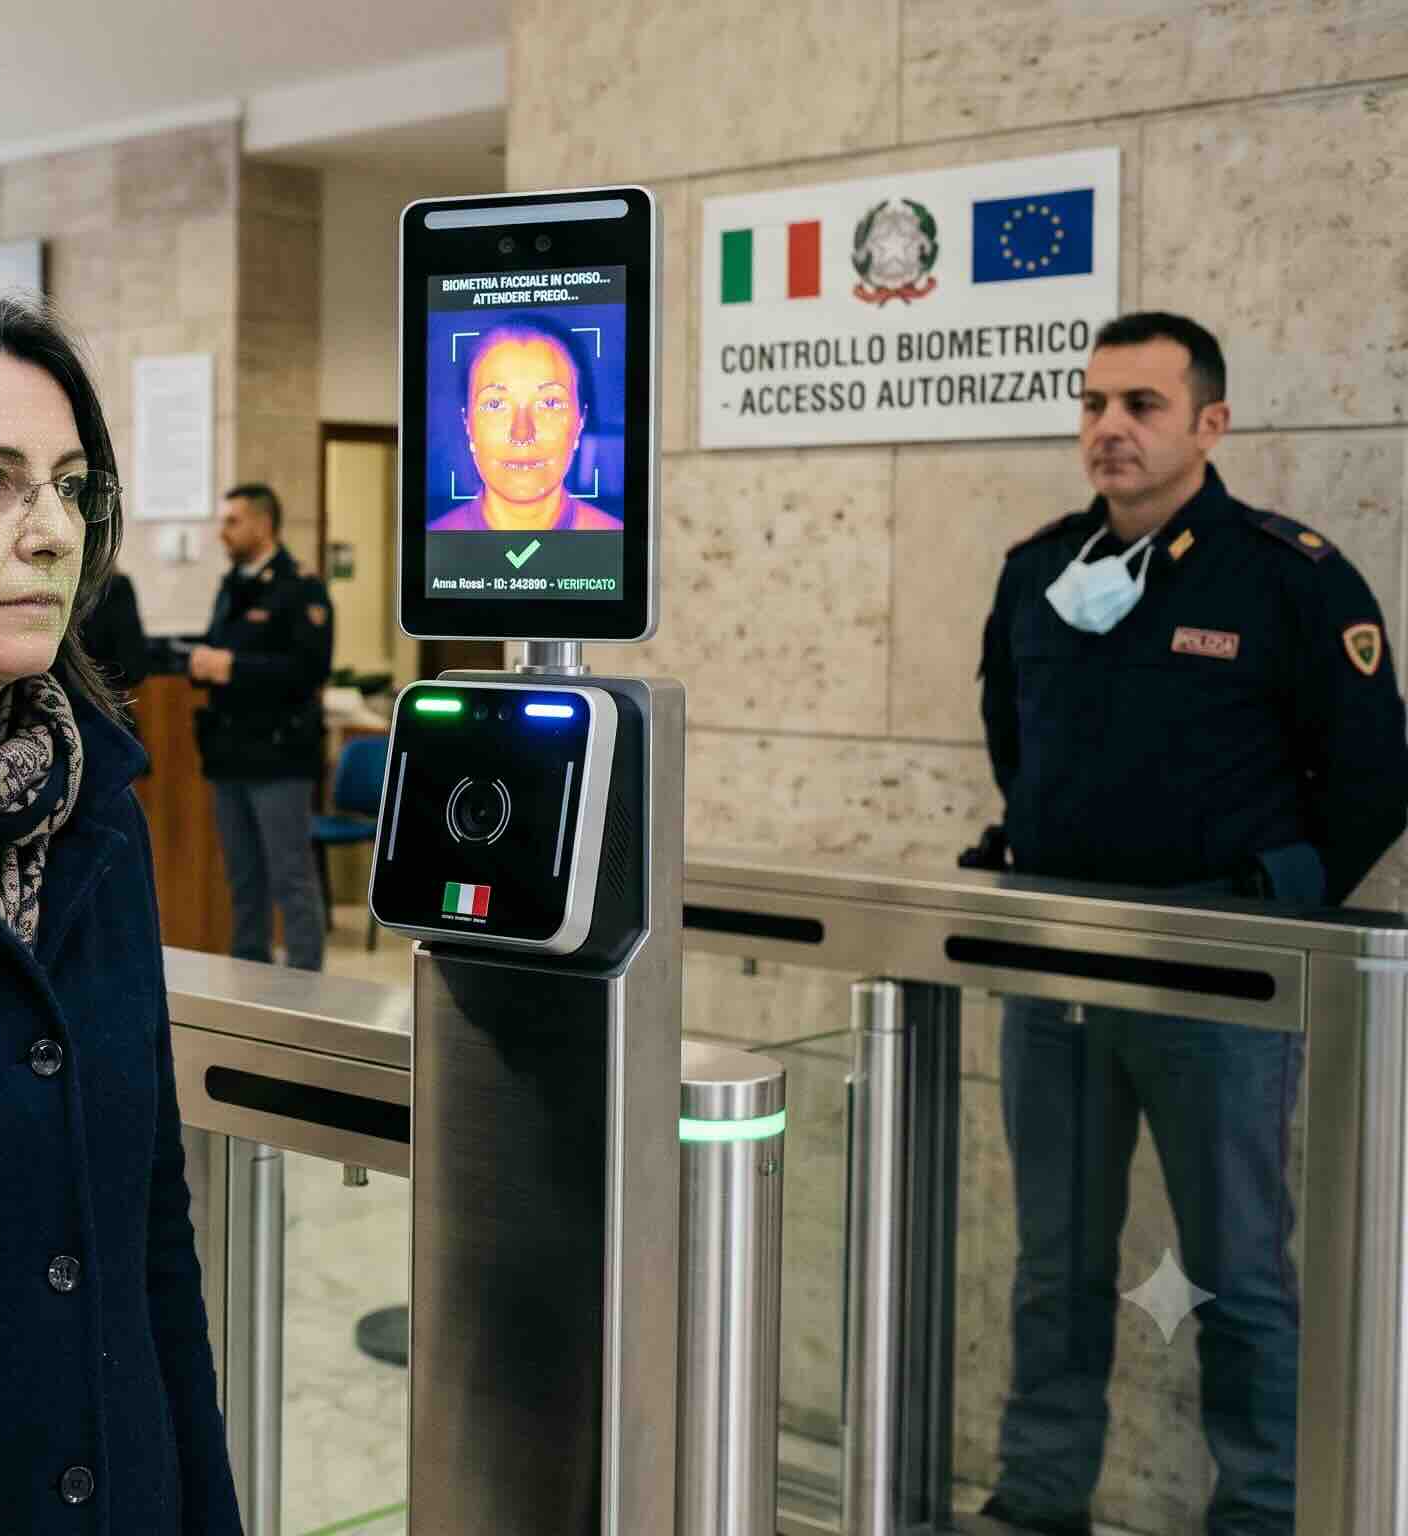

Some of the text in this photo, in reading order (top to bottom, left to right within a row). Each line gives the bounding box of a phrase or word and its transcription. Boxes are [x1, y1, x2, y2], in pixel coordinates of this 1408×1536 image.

[442, 271, 611, 292] BIOMETRIA FACCIALE IN CORSO...
[472, 288, 580, 305] ATTENDERE PREGO...
[721, 319, 1090, 375] CONTROLLO BIOMETRICO
[740, 380, 866, 416] ACCESSO
[877, 367, 1087, 409] AUTORIZZATO
[432, 576, 457, 590] Anna
[493, 577, 508, 590] ID:
[556, 578, 616, 591] VERIFICATO
